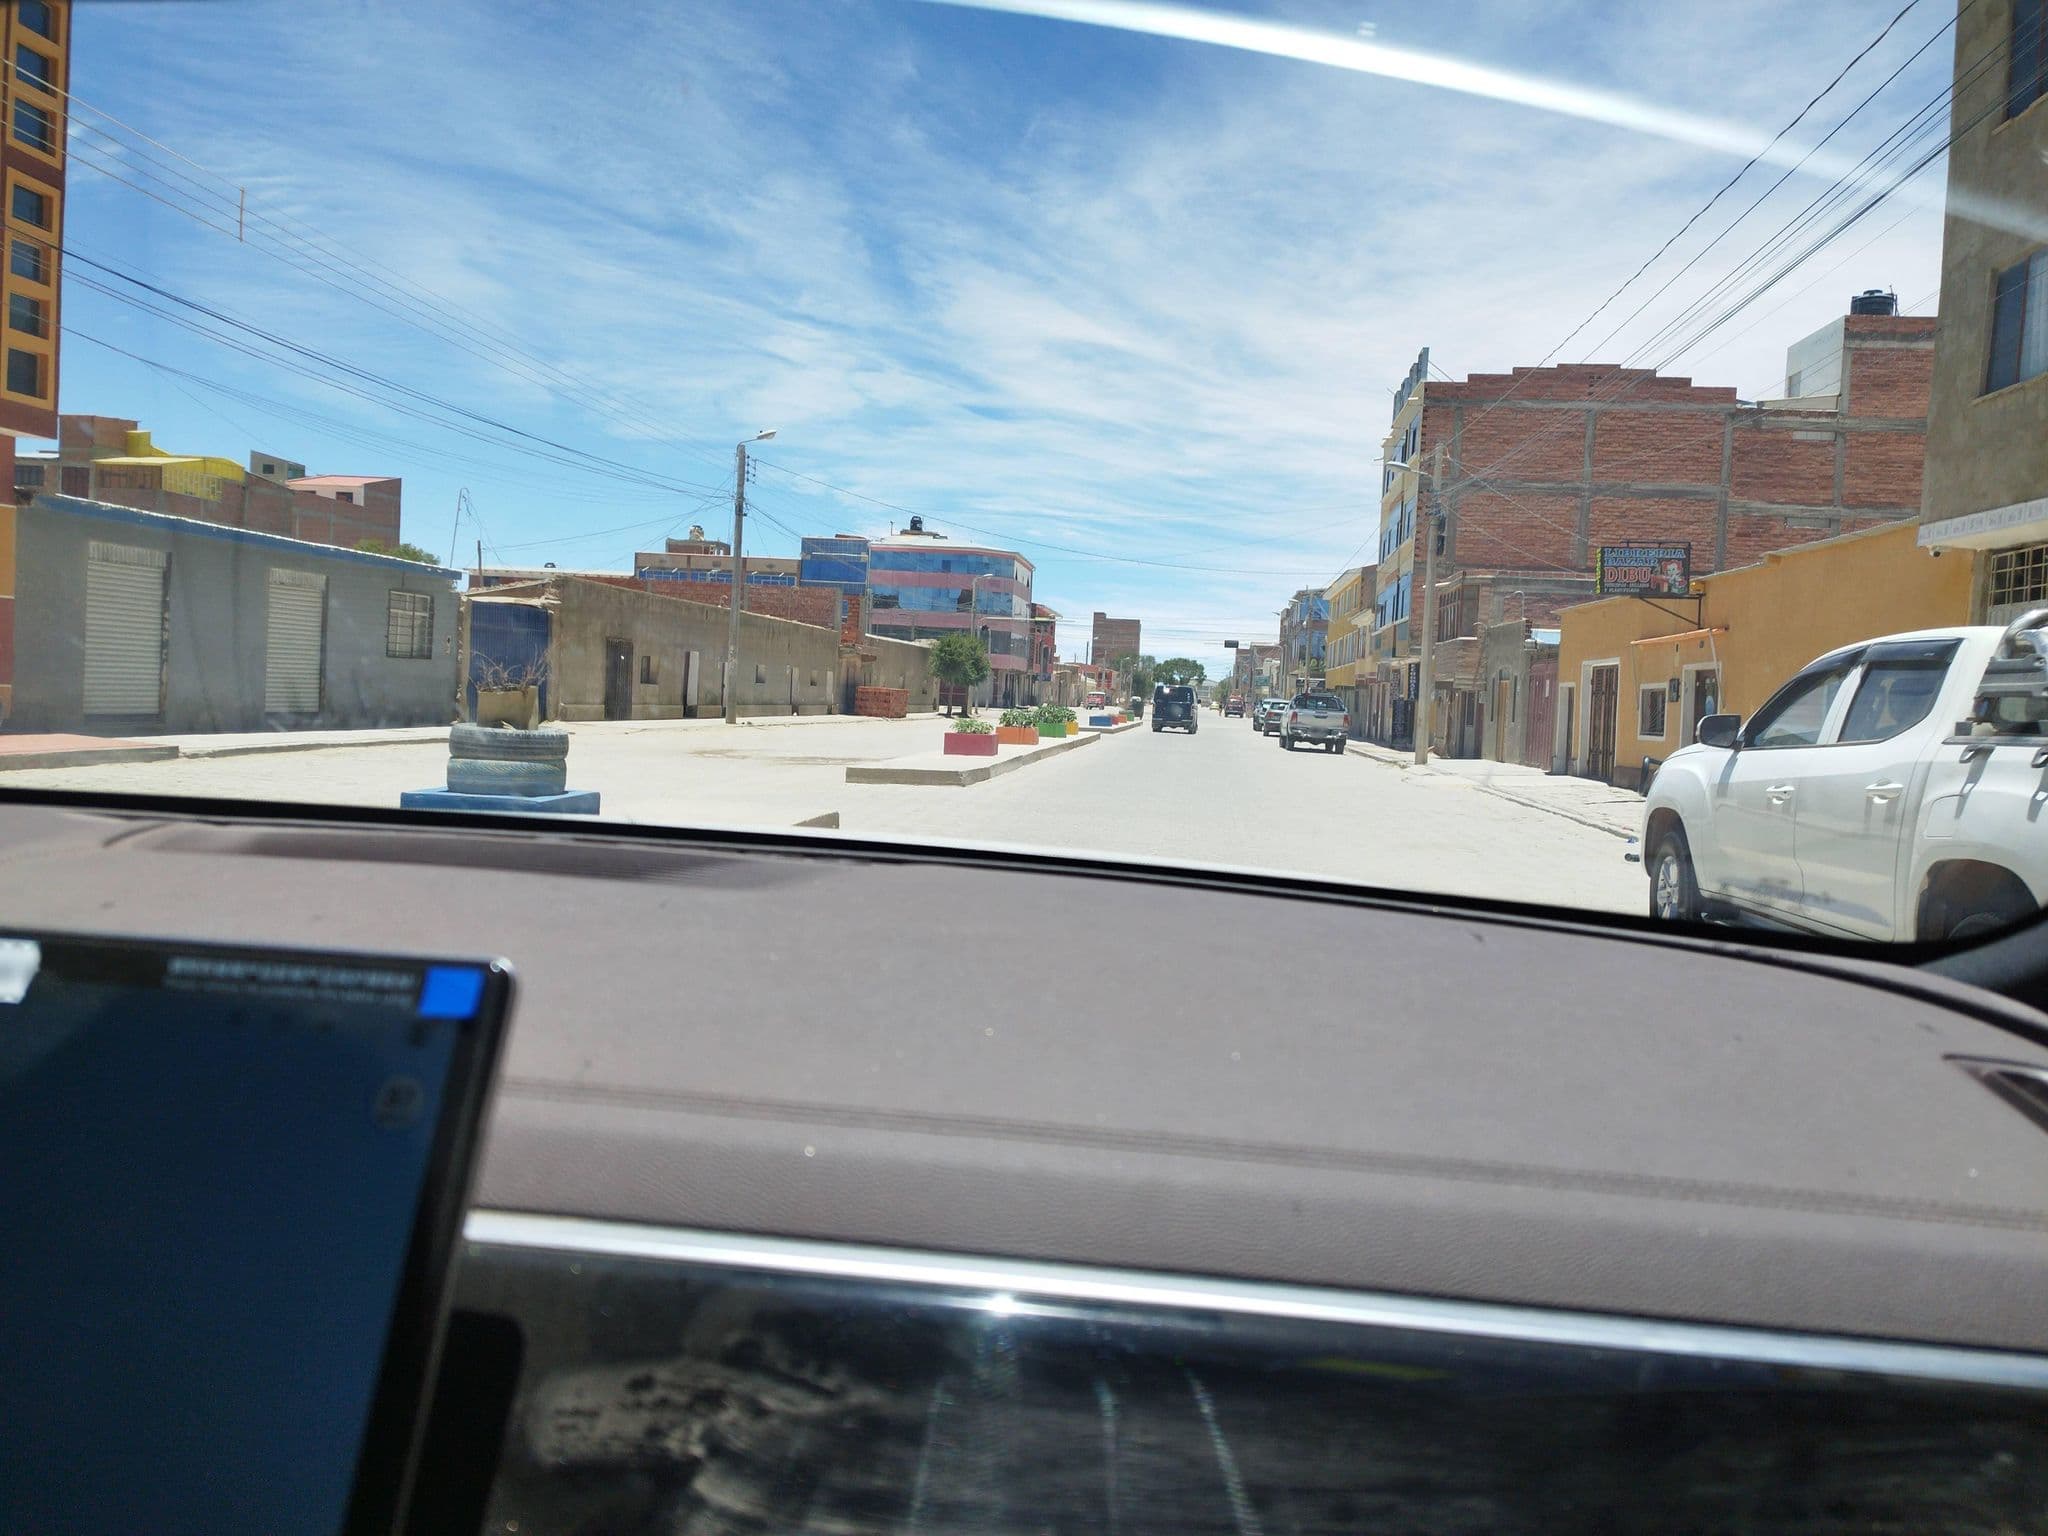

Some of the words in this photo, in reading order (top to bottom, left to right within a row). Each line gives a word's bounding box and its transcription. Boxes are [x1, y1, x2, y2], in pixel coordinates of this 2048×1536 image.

[1604, 548, 1685, 558] LIBRERIA
[1604, 558, 1658, 566] BAZAR
[1604, 567, 1651, 583] DIBU
